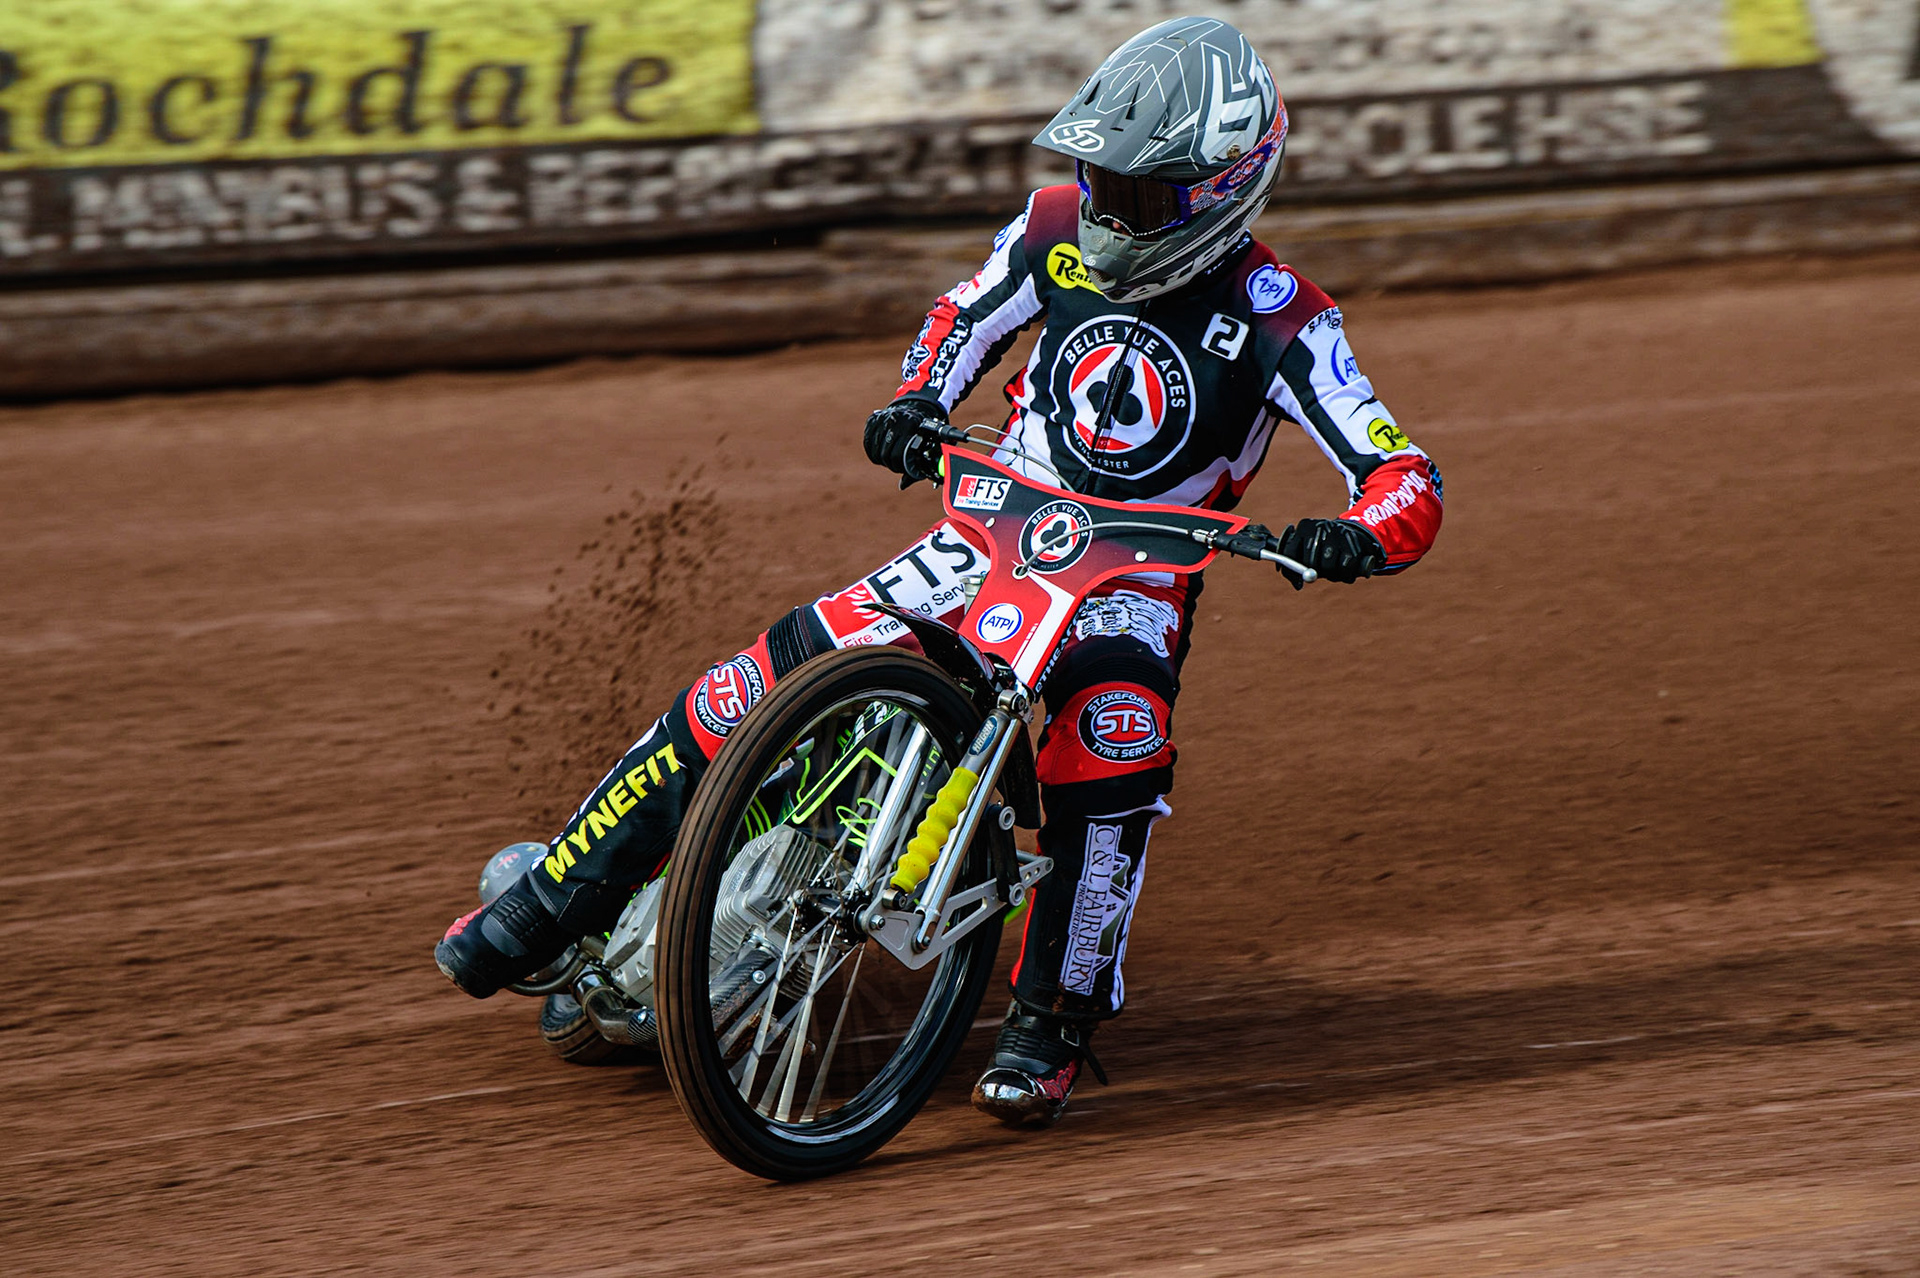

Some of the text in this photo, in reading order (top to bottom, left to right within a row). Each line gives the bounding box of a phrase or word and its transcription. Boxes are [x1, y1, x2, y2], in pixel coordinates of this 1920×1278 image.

[1207, 316, 1240, 358] 2
[1064, 325, 1115, 365] BELLE
[1157, 358, 1187, 409] ACES
[973, 478, 1008, 500] FTS
[1031, 504, 1089, 537] BELLE VUE ACS
[866, 531, 976, 605] FTS
[985, 615, 1014, 631] ATPI
[713, 665, 746, 719] STS
[734, 656, 762, 706] STAKEFOR
[697, 694, 728, 735] SERVICES
[1088, 693, 1151, 714] STAKEFORD
[1096, 709, 1152, 736] STS
[1092, 736, 1165, 758] TYRE SERVICES
[544, 742, 681, 883] MYNEFIT
[1068, 828, 1116, 991] C & L FAIRBURN
[1071, 884, 1087, 937] PROPERTIES
